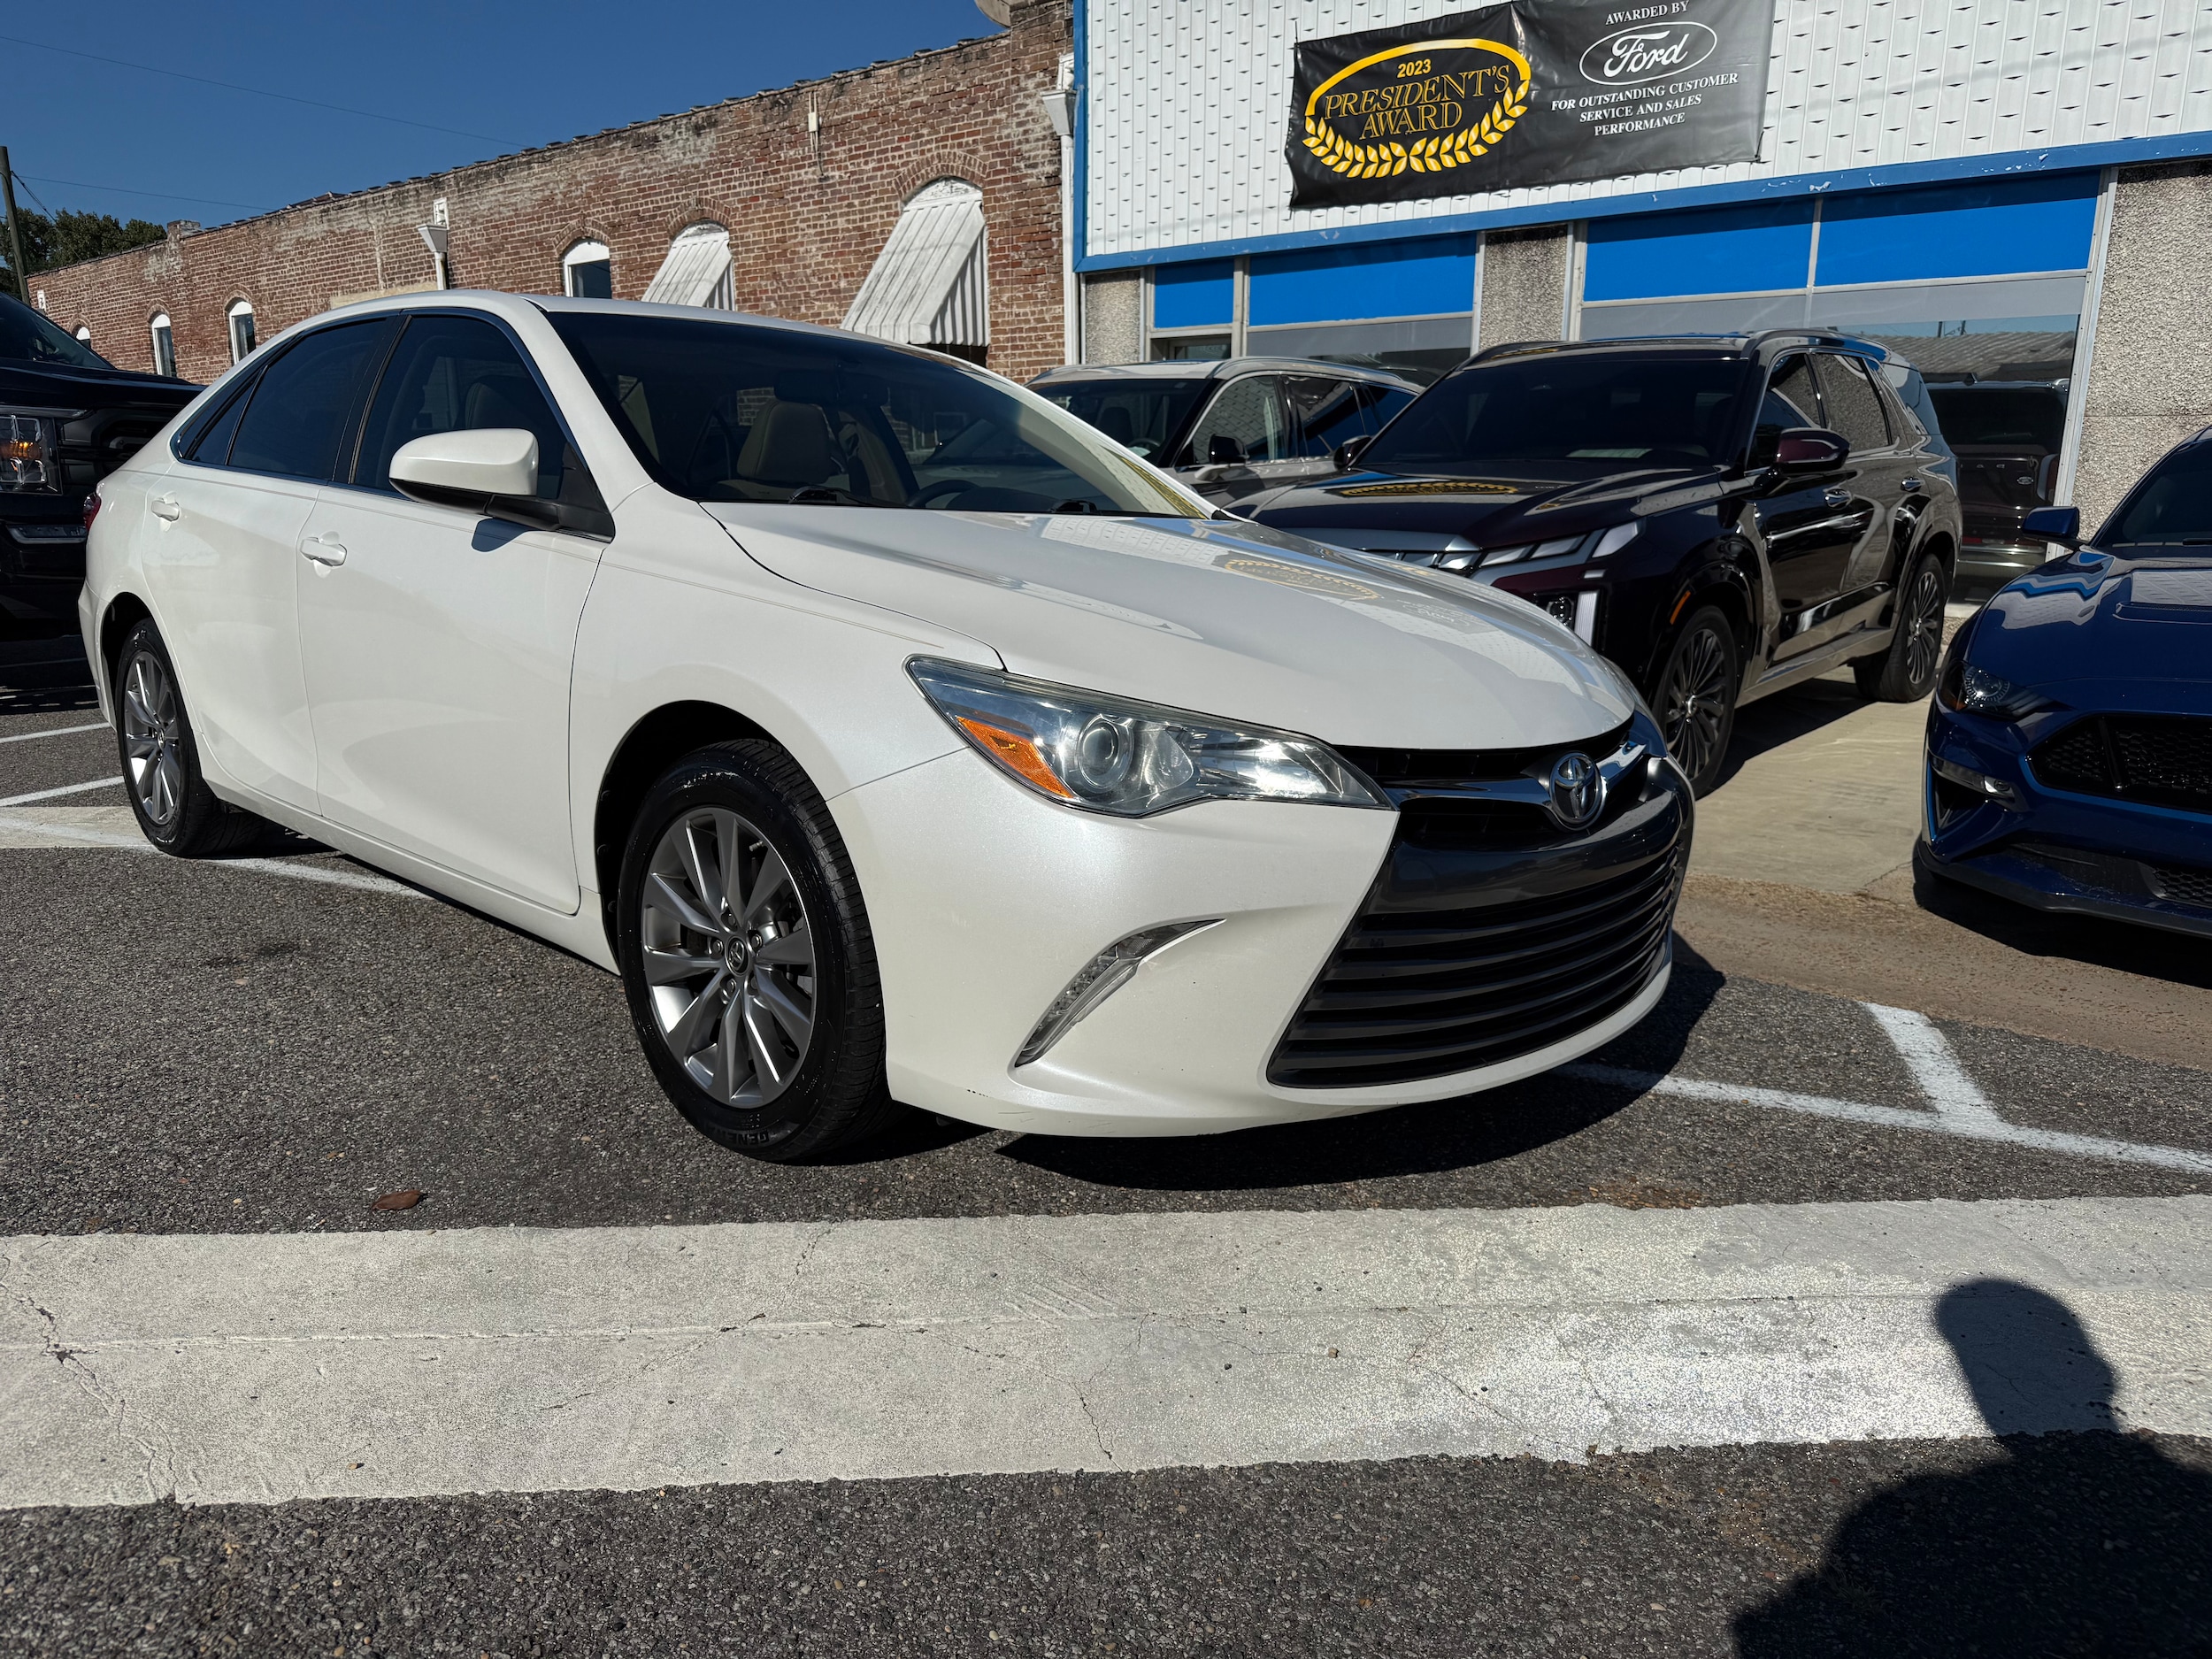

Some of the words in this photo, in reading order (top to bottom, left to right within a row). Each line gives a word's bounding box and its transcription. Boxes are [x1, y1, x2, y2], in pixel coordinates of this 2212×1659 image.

[1605, 4, 1668, 26] AWARDED
[1671, 1, 1690, 14] BY
[1397, 58, 1432, 78] 2023
[1603, 30, 1690, 78] Ford
[1325, 65, 1510, 119] PRESIDENT'S
[1551, 99, 1576, 111] FOR
[1578, 86, 1665, 107] OUTSTANDING
[1669, 73, 1739, 94] CUSTOMER
[1579, 105, 1633, 122] SERVICE
[1636, 102, 1663, 115] AND
[1665, 94, 1702, 111] SALES
[1359, 101, 1463, 140] AWARD
[1594, 112, 1686, 136] PERFORMANCE
